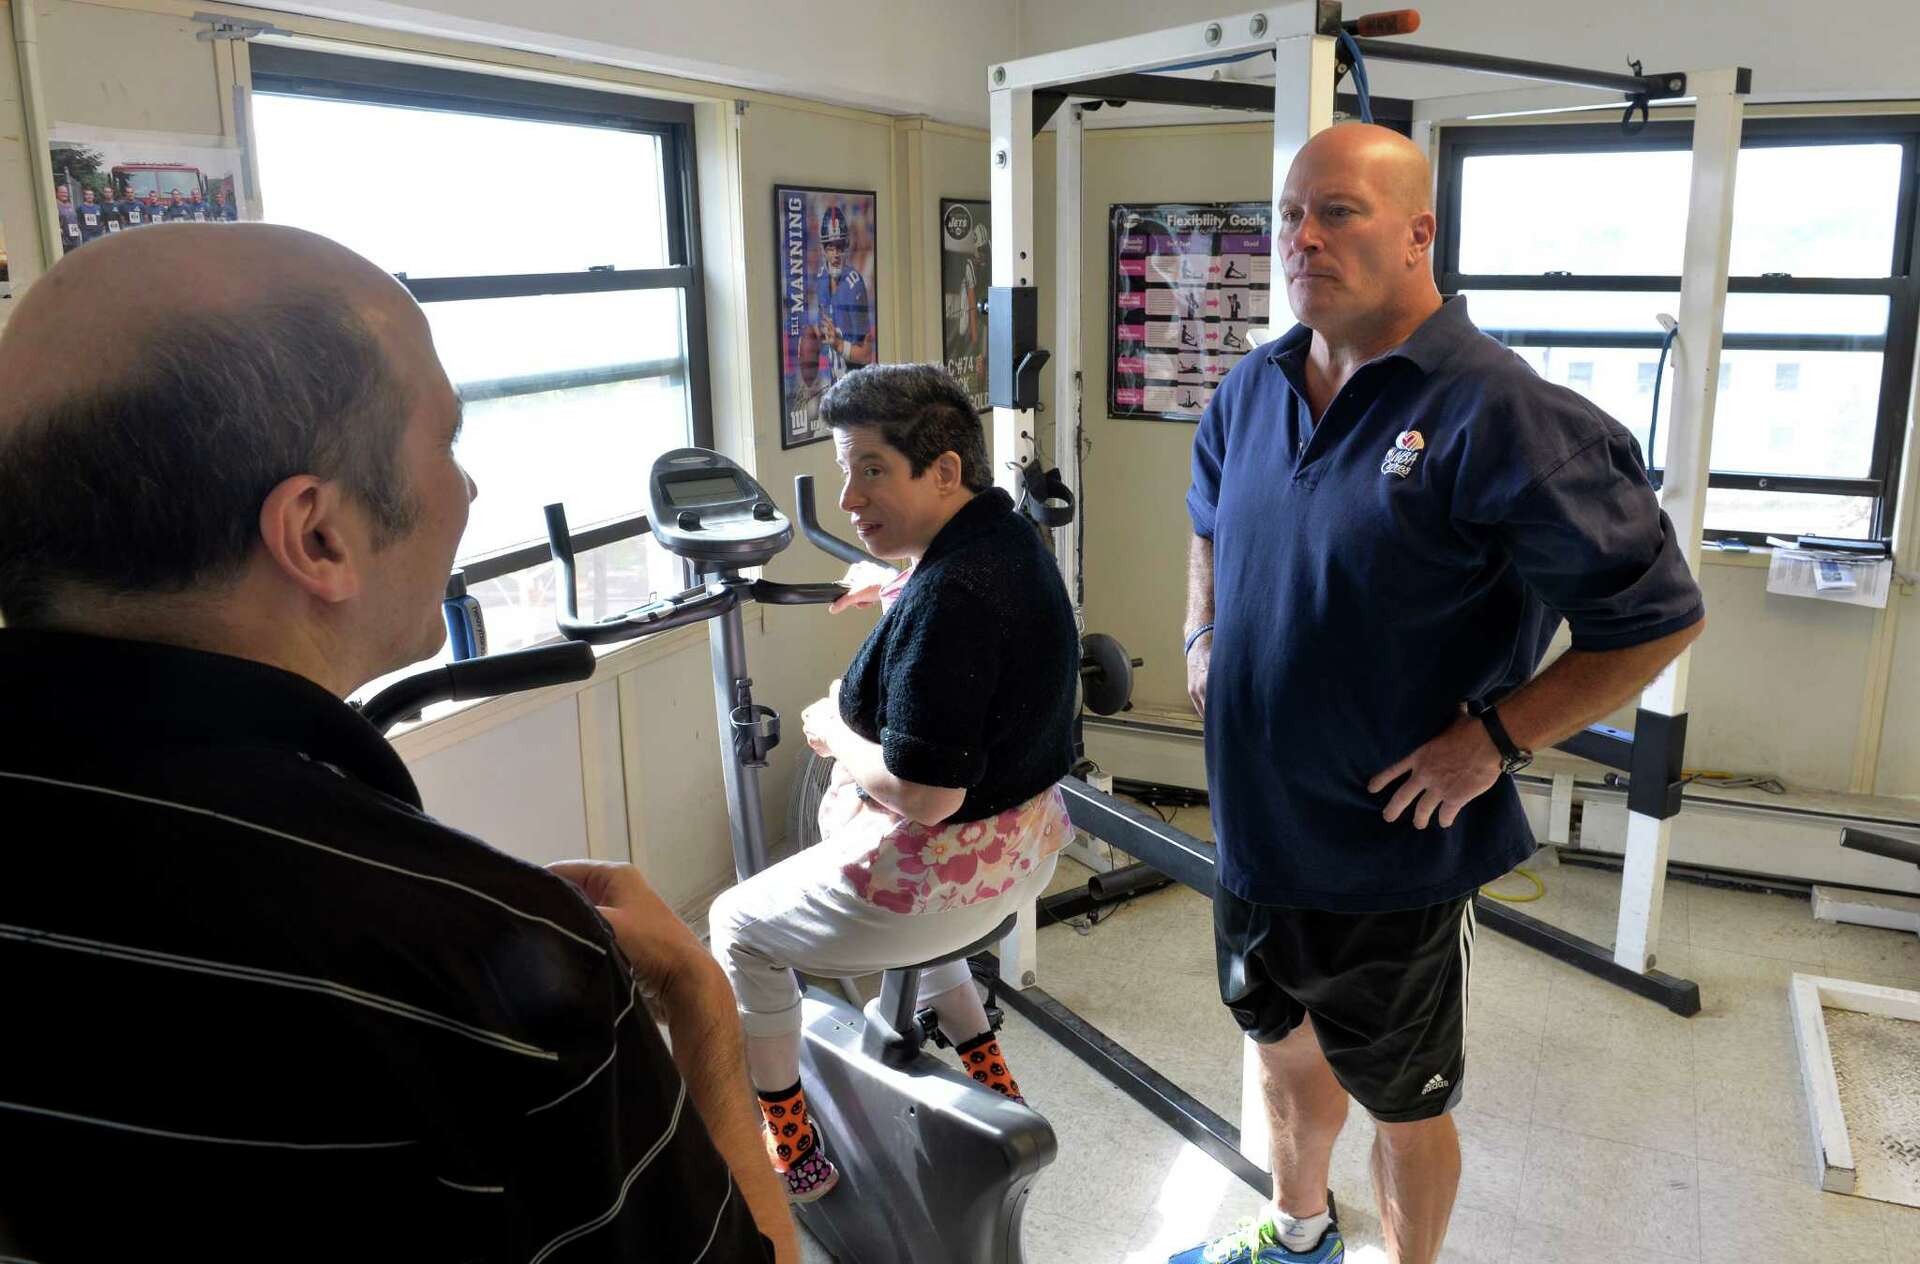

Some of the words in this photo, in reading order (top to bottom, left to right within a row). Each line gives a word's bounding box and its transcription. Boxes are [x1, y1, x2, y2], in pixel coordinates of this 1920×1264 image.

[1167, 213, 1226, 228] Flexibility
[1230, 213, 1266, 226] Goals
[789, 197, 804, 313] MANNING
[791, 316, 799, 336] ELI
